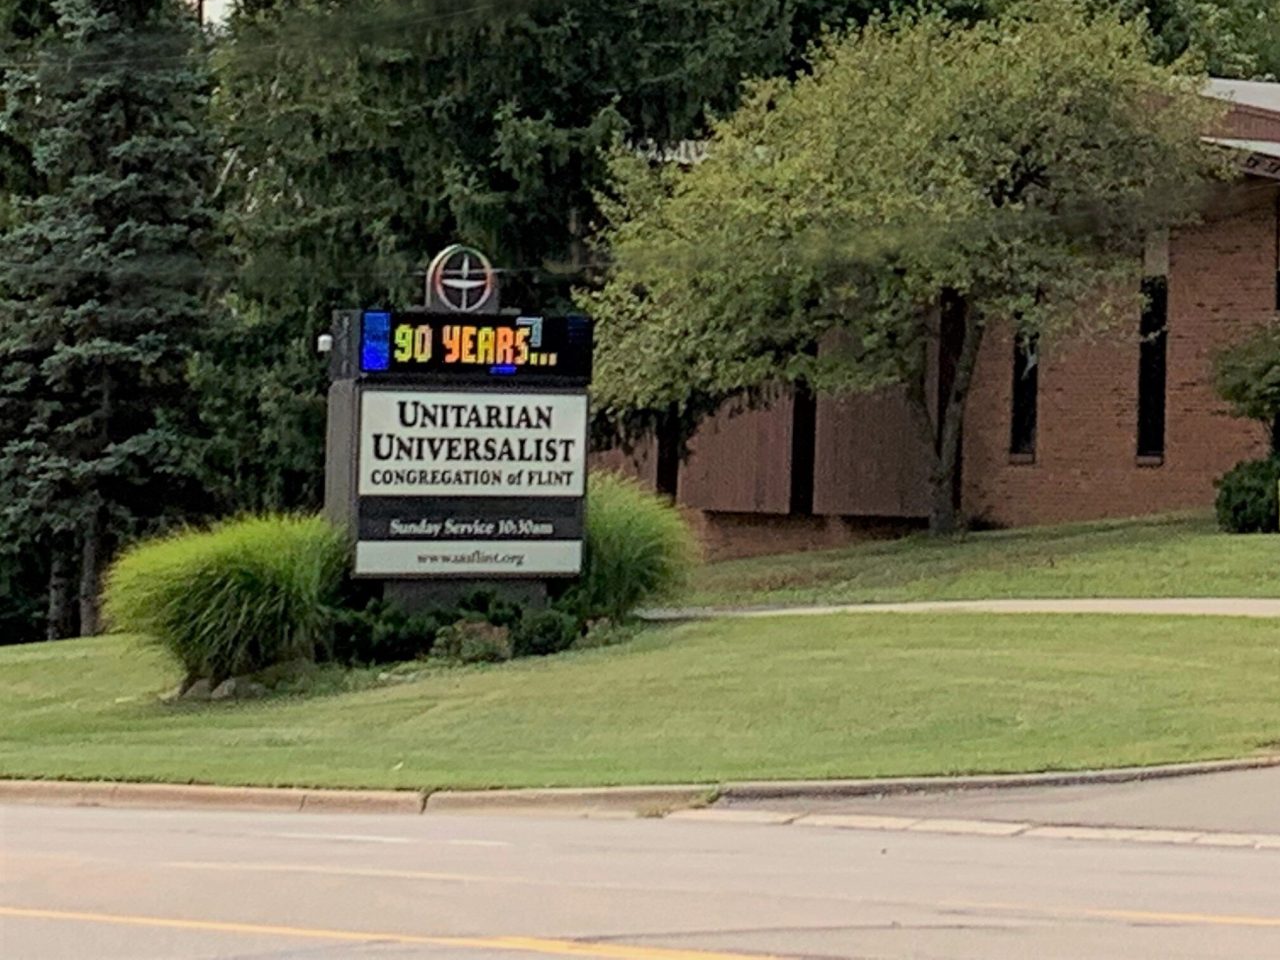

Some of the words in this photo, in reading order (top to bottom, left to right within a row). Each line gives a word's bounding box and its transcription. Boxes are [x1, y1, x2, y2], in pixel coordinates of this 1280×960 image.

[394, 323, 433, 363] 90
[398, 401, 553, 429] UNITARIAN
[372, 434, 575, 462] UNIVERSALIST
[371, 470, 502, 486] CONGREGATION
[507, 470, 522, 486] of
[527, 471, 573, 487] FLINT
[389, 518, 442, 537] Sunday
[445, 519, 494, 535] Service
